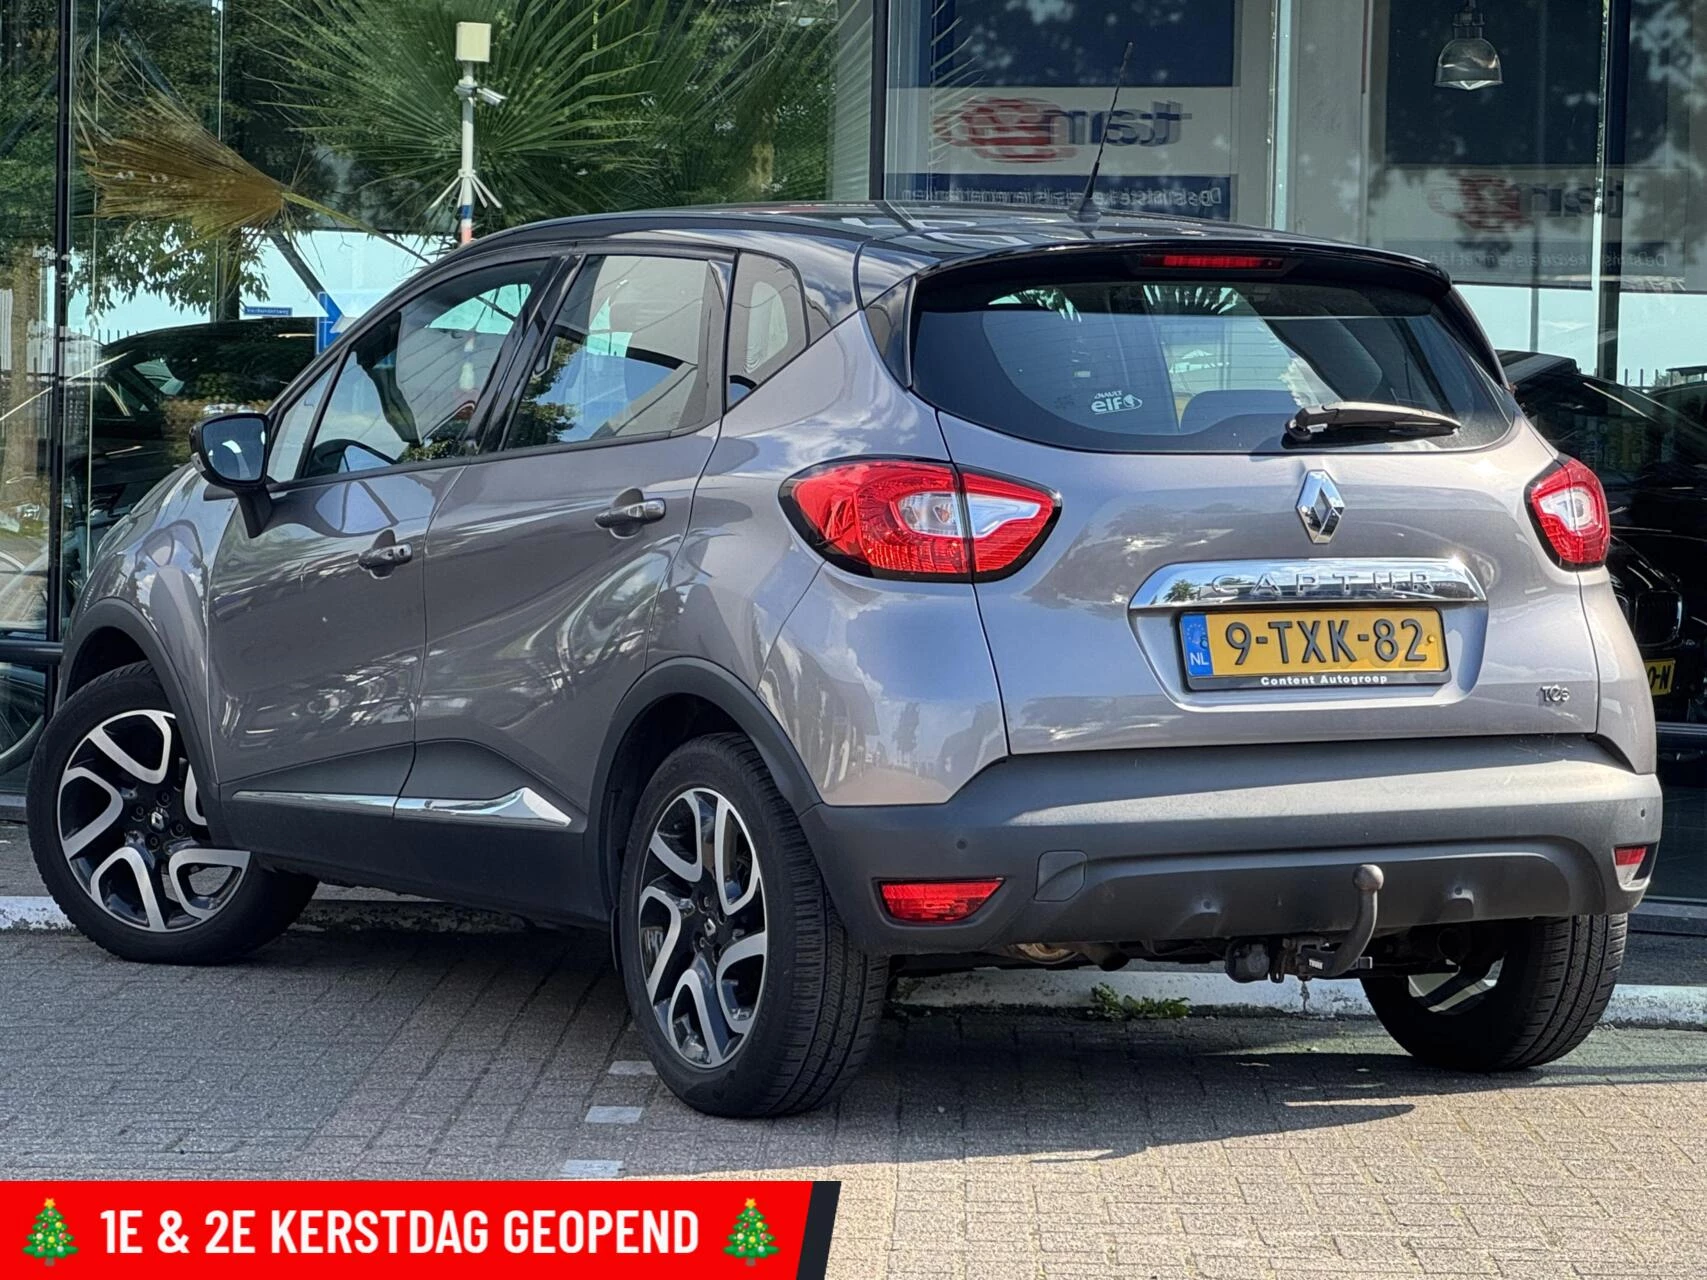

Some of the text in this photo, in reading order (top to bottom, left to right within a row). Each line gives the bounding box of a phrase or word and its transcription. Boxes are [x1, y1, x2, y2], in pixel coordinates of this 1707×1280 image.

[1091, 397, 1122, 413] elf
[1211, 571, 1435, 597] CAPTUR
[1224, 618, 1428, 666] 9-TXK-82
[1190, 652, 1210, 666] NL
[1260, 675, 1388, 686] Content Autogroep
